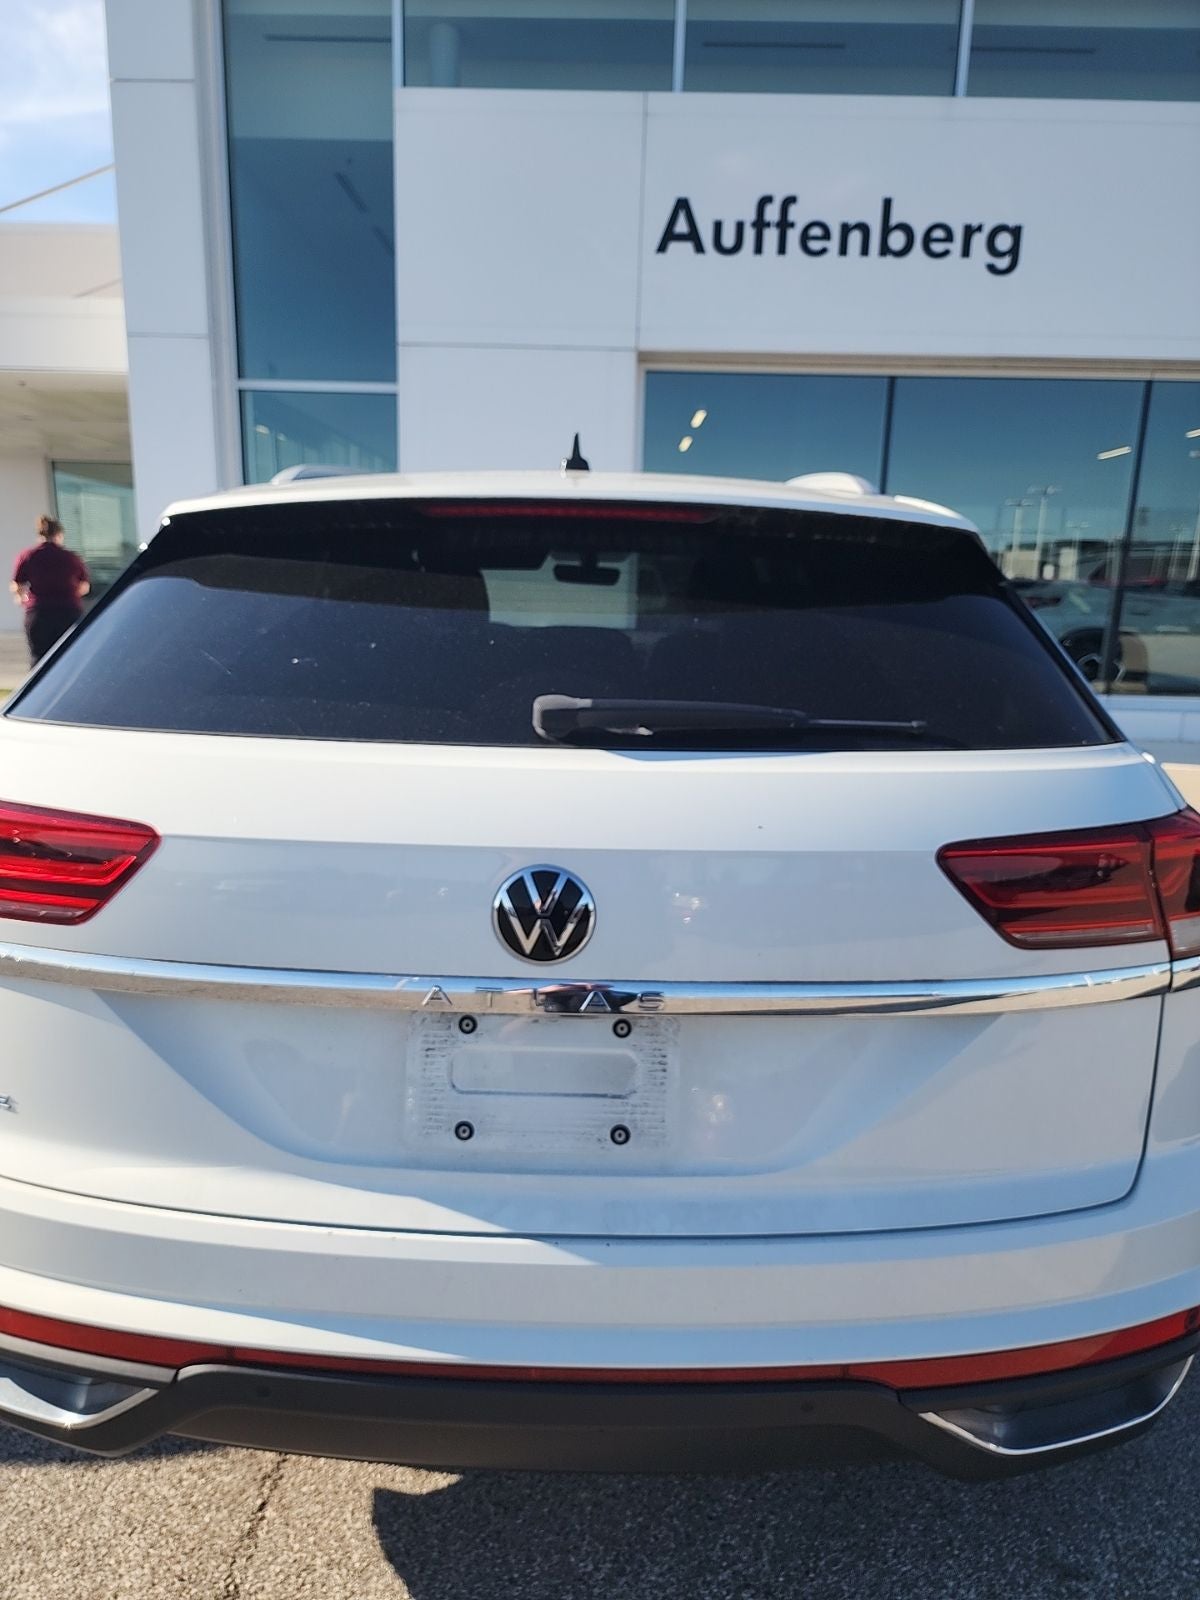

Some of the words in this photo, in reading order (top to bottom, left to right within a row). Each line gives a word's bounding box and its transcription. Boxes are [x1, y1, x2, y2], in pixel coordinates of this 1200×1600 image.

[656, 195, 1023, 276] Auffenberg
[492, 864, 597, 965] VW
[422, 984, 665, 1012] ATLAS
